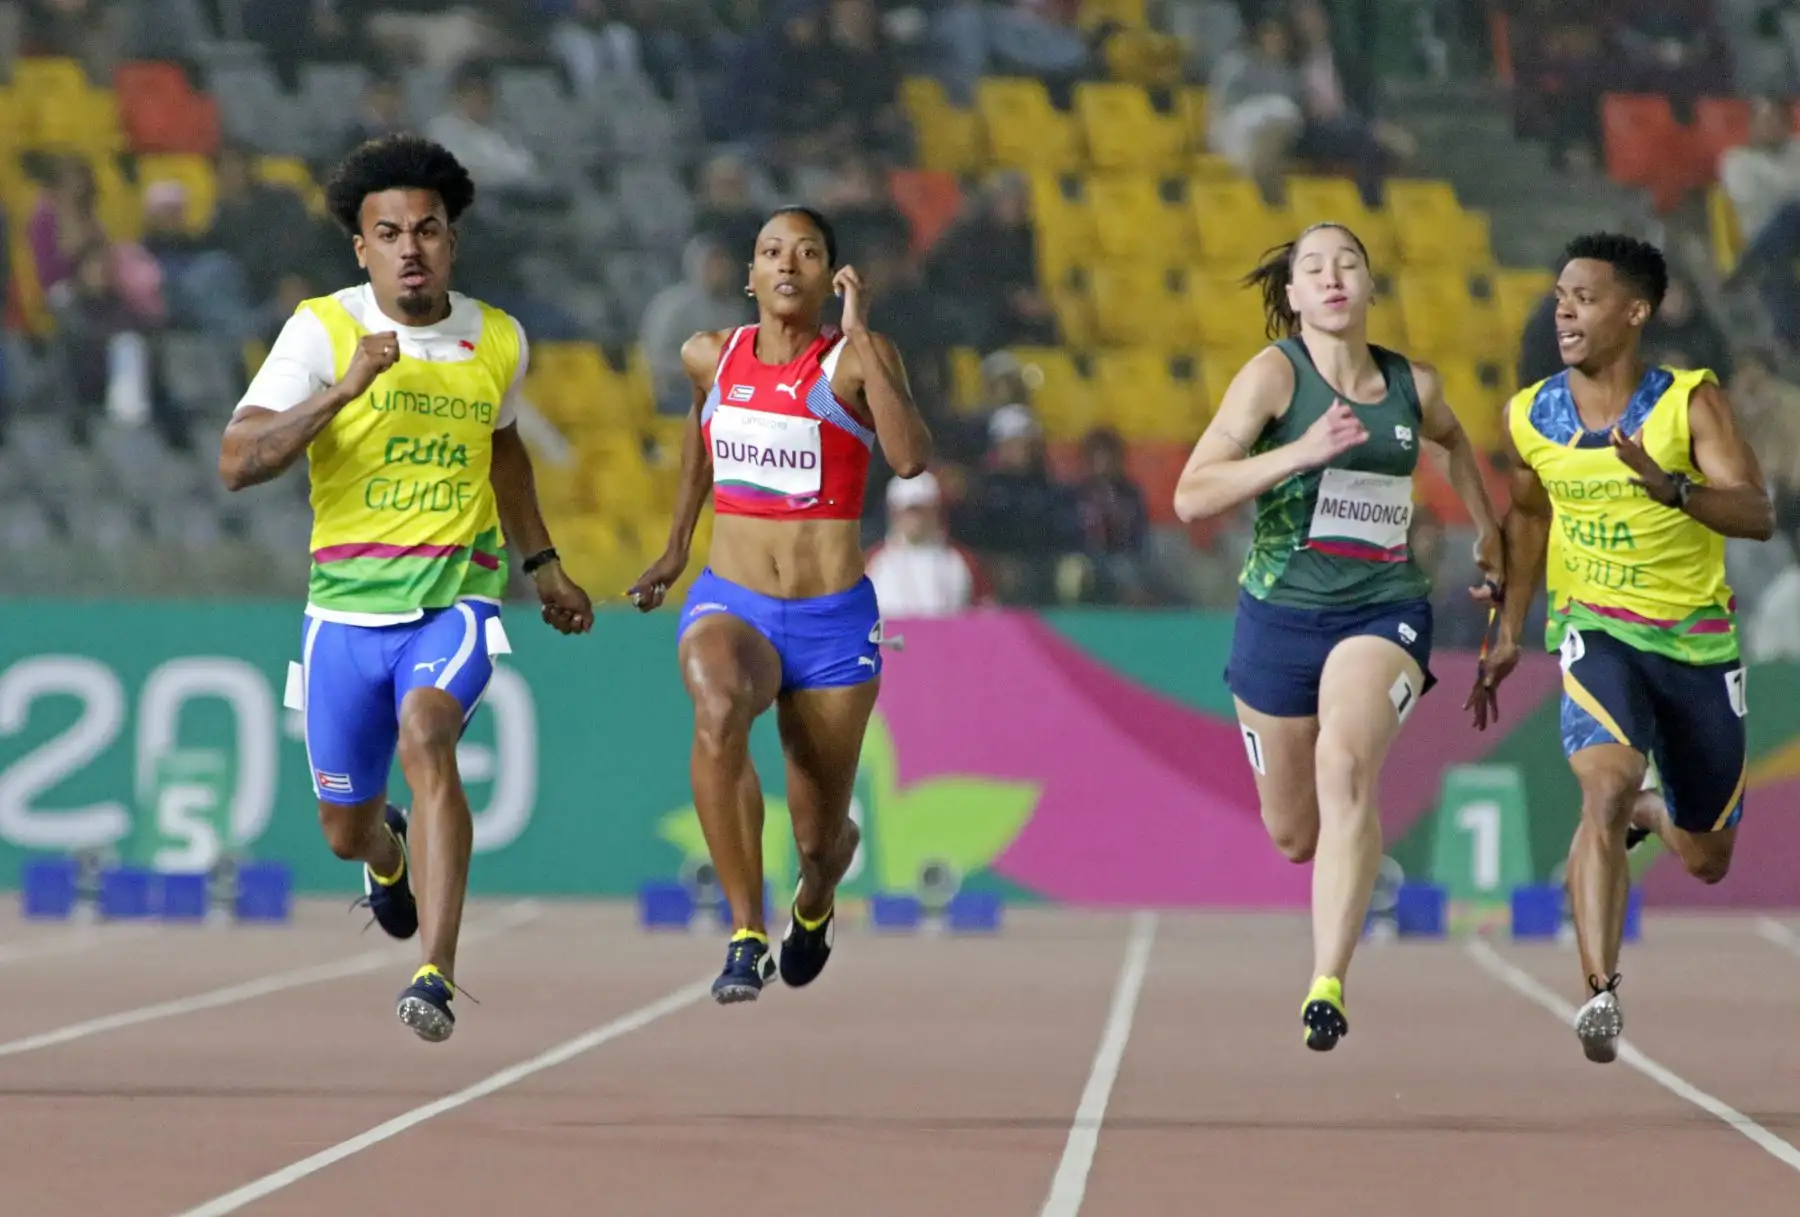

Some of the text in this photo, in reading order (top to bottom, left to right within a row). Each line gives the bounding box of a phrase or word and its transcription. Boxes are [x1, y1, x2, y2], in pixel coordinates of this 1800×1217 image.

[715, 439, 817, 470] DURAND
[1320, 497, 1408, 526] MENDONCA
[1734, 671, 1743, 712] 1
[155, 784, 219, 875] 5
[1458, 802, 1500, 889] 1
